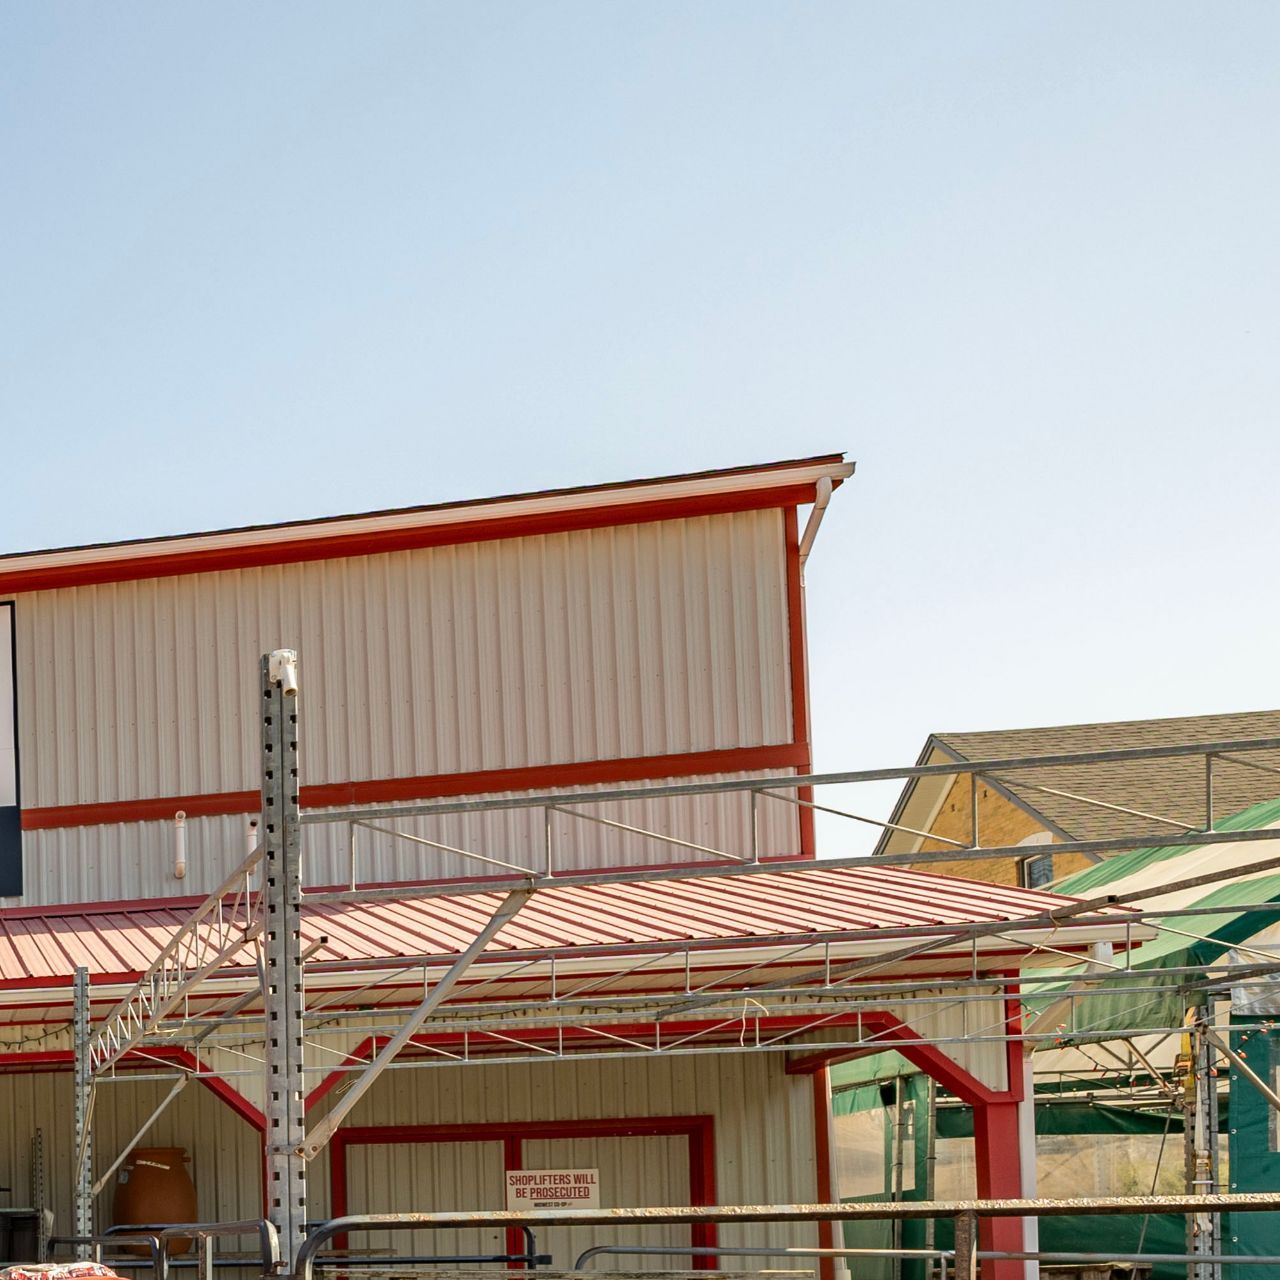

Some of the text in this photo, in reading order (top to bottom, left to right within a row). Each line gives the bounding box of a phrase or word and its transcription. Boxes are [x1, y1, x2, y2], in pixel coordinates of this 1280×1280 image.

[509, 1173, 596, 1186] SHOPLIFTERS WILL
[515, 1186, 590, 1199] BE PROSECUTED
